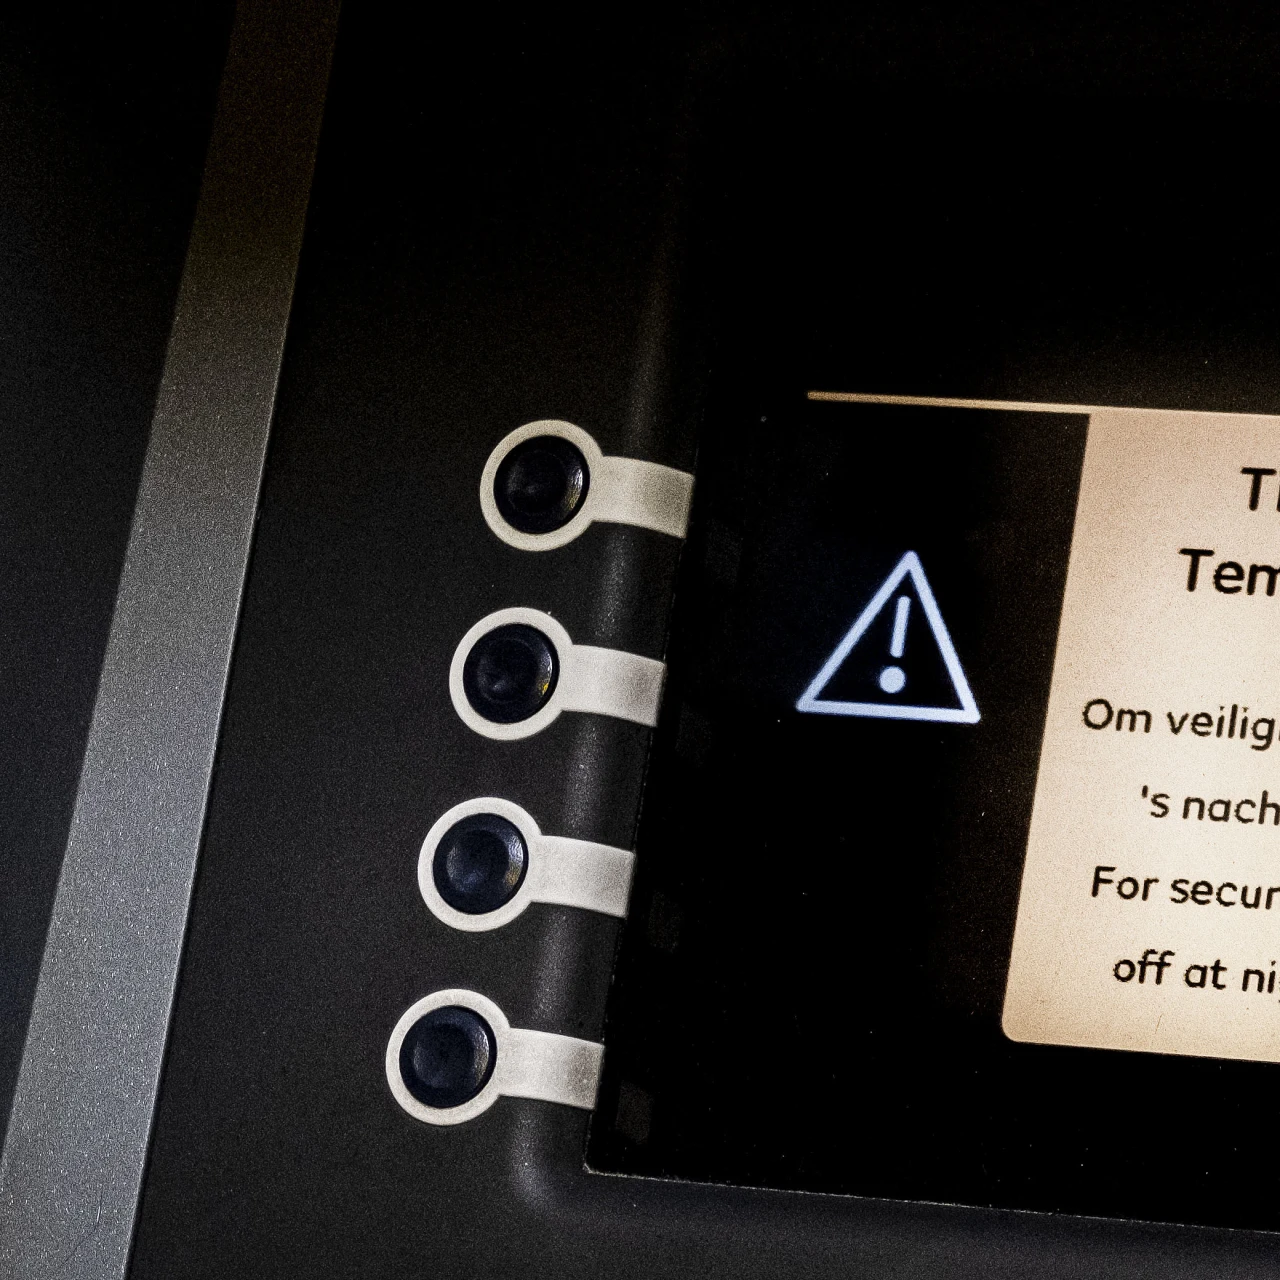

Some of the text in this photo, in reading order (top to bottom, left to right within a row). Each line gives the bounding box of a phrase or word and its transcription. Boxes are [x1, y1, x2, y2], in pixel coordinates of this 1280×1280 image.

[1081, 697, 1153, 734] Om
[1140, 784, 1170, 819] 's
[1090, 864, 1160, 902] For
[1112, 948, 1175, 986] off
[1183, 959, 1228, 991] at
